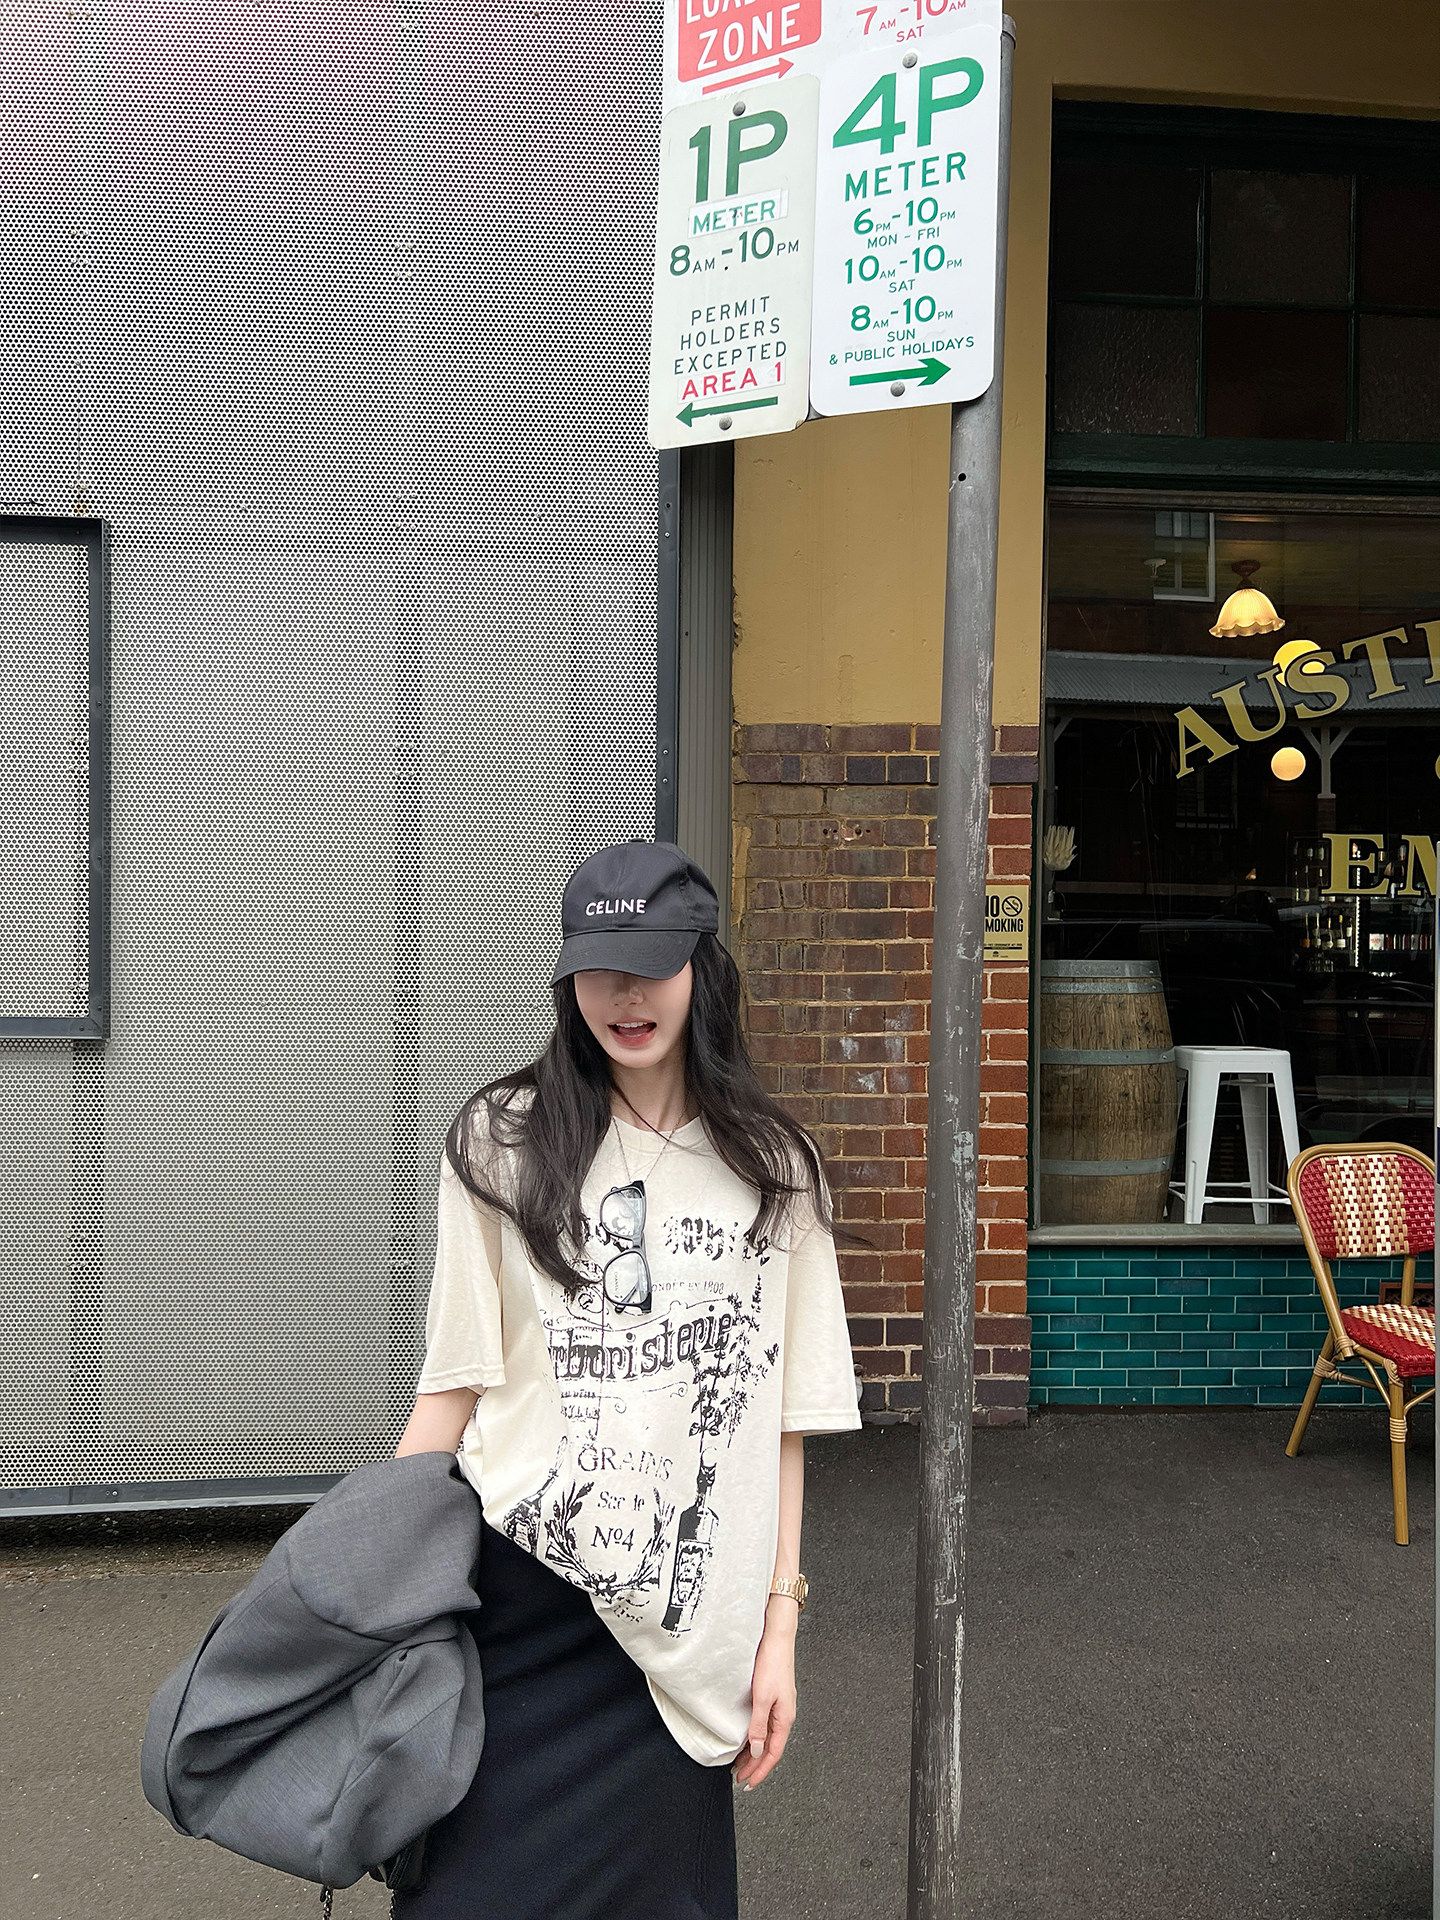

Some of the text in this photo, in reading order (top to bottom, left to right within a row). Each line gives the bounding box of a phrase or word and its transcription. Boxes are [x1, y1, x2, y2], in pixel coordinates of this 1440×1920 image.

[697, 2, 801, 71] ZONE
[896, 25, 925, 43] SAT
[832, 57, 985, 155] 4P
[688, 110, 788, 204] 1P
[845, 151, 967, 202] METER
[692, 199, 776, 236] METER
[867, 234, 898, 249] MON
[917, 226, 940, 241] FRI
[888, 279, 916, 293] SAT
[690, 295, 770, 326] PERMIT
[680, 317, 780, 351] HOLDERS
[887, 328, 916, 343] SUN
[674, 341, 787, 375] EXCEPTED
[829, 336, 975, 365] & PUBLIC HOLIDAYS
[681, 361, 781, 400] AREA 1
[585, 899, 647, 916] CELINE
[985, 918, 1024, 933] MOKING
